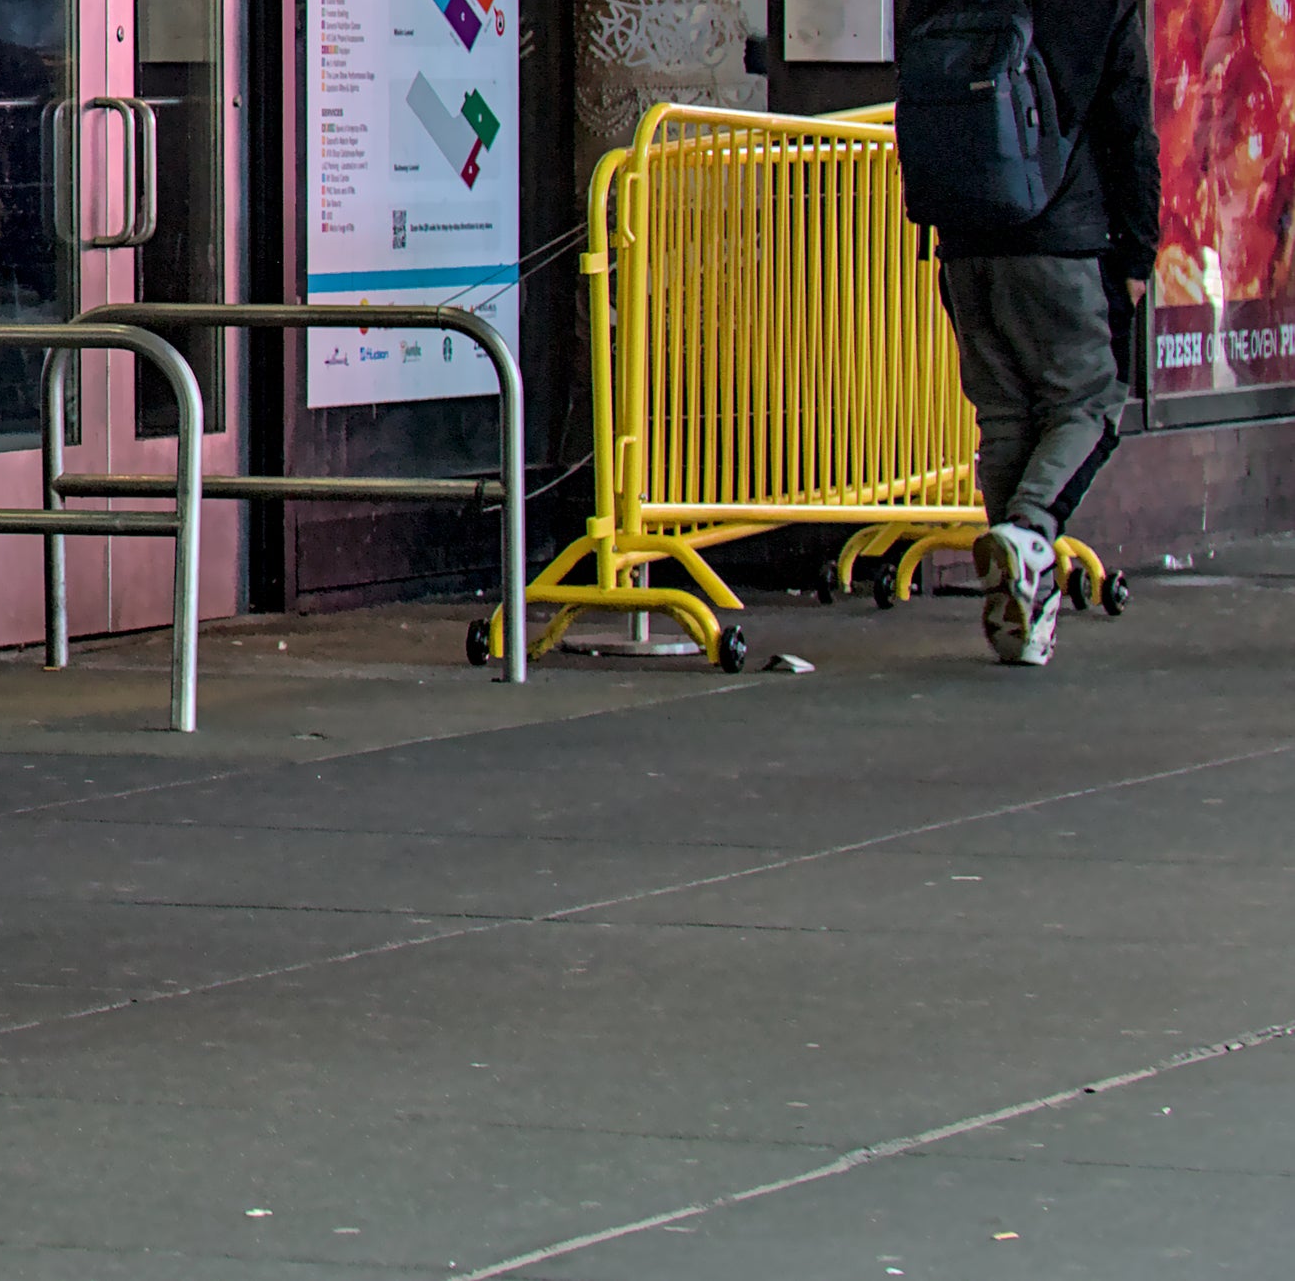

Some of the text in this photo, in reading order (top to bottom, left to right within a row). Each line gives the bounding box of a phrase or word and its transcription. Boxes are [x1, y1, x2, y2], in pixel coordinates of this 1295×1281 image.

[321, 108, 344, 117] SERVICES
[1156, 332, 1202, 369] FRESH
[1228, 329, 1249, 361] THE
[1250, 327, 1277, 359] OVEN
